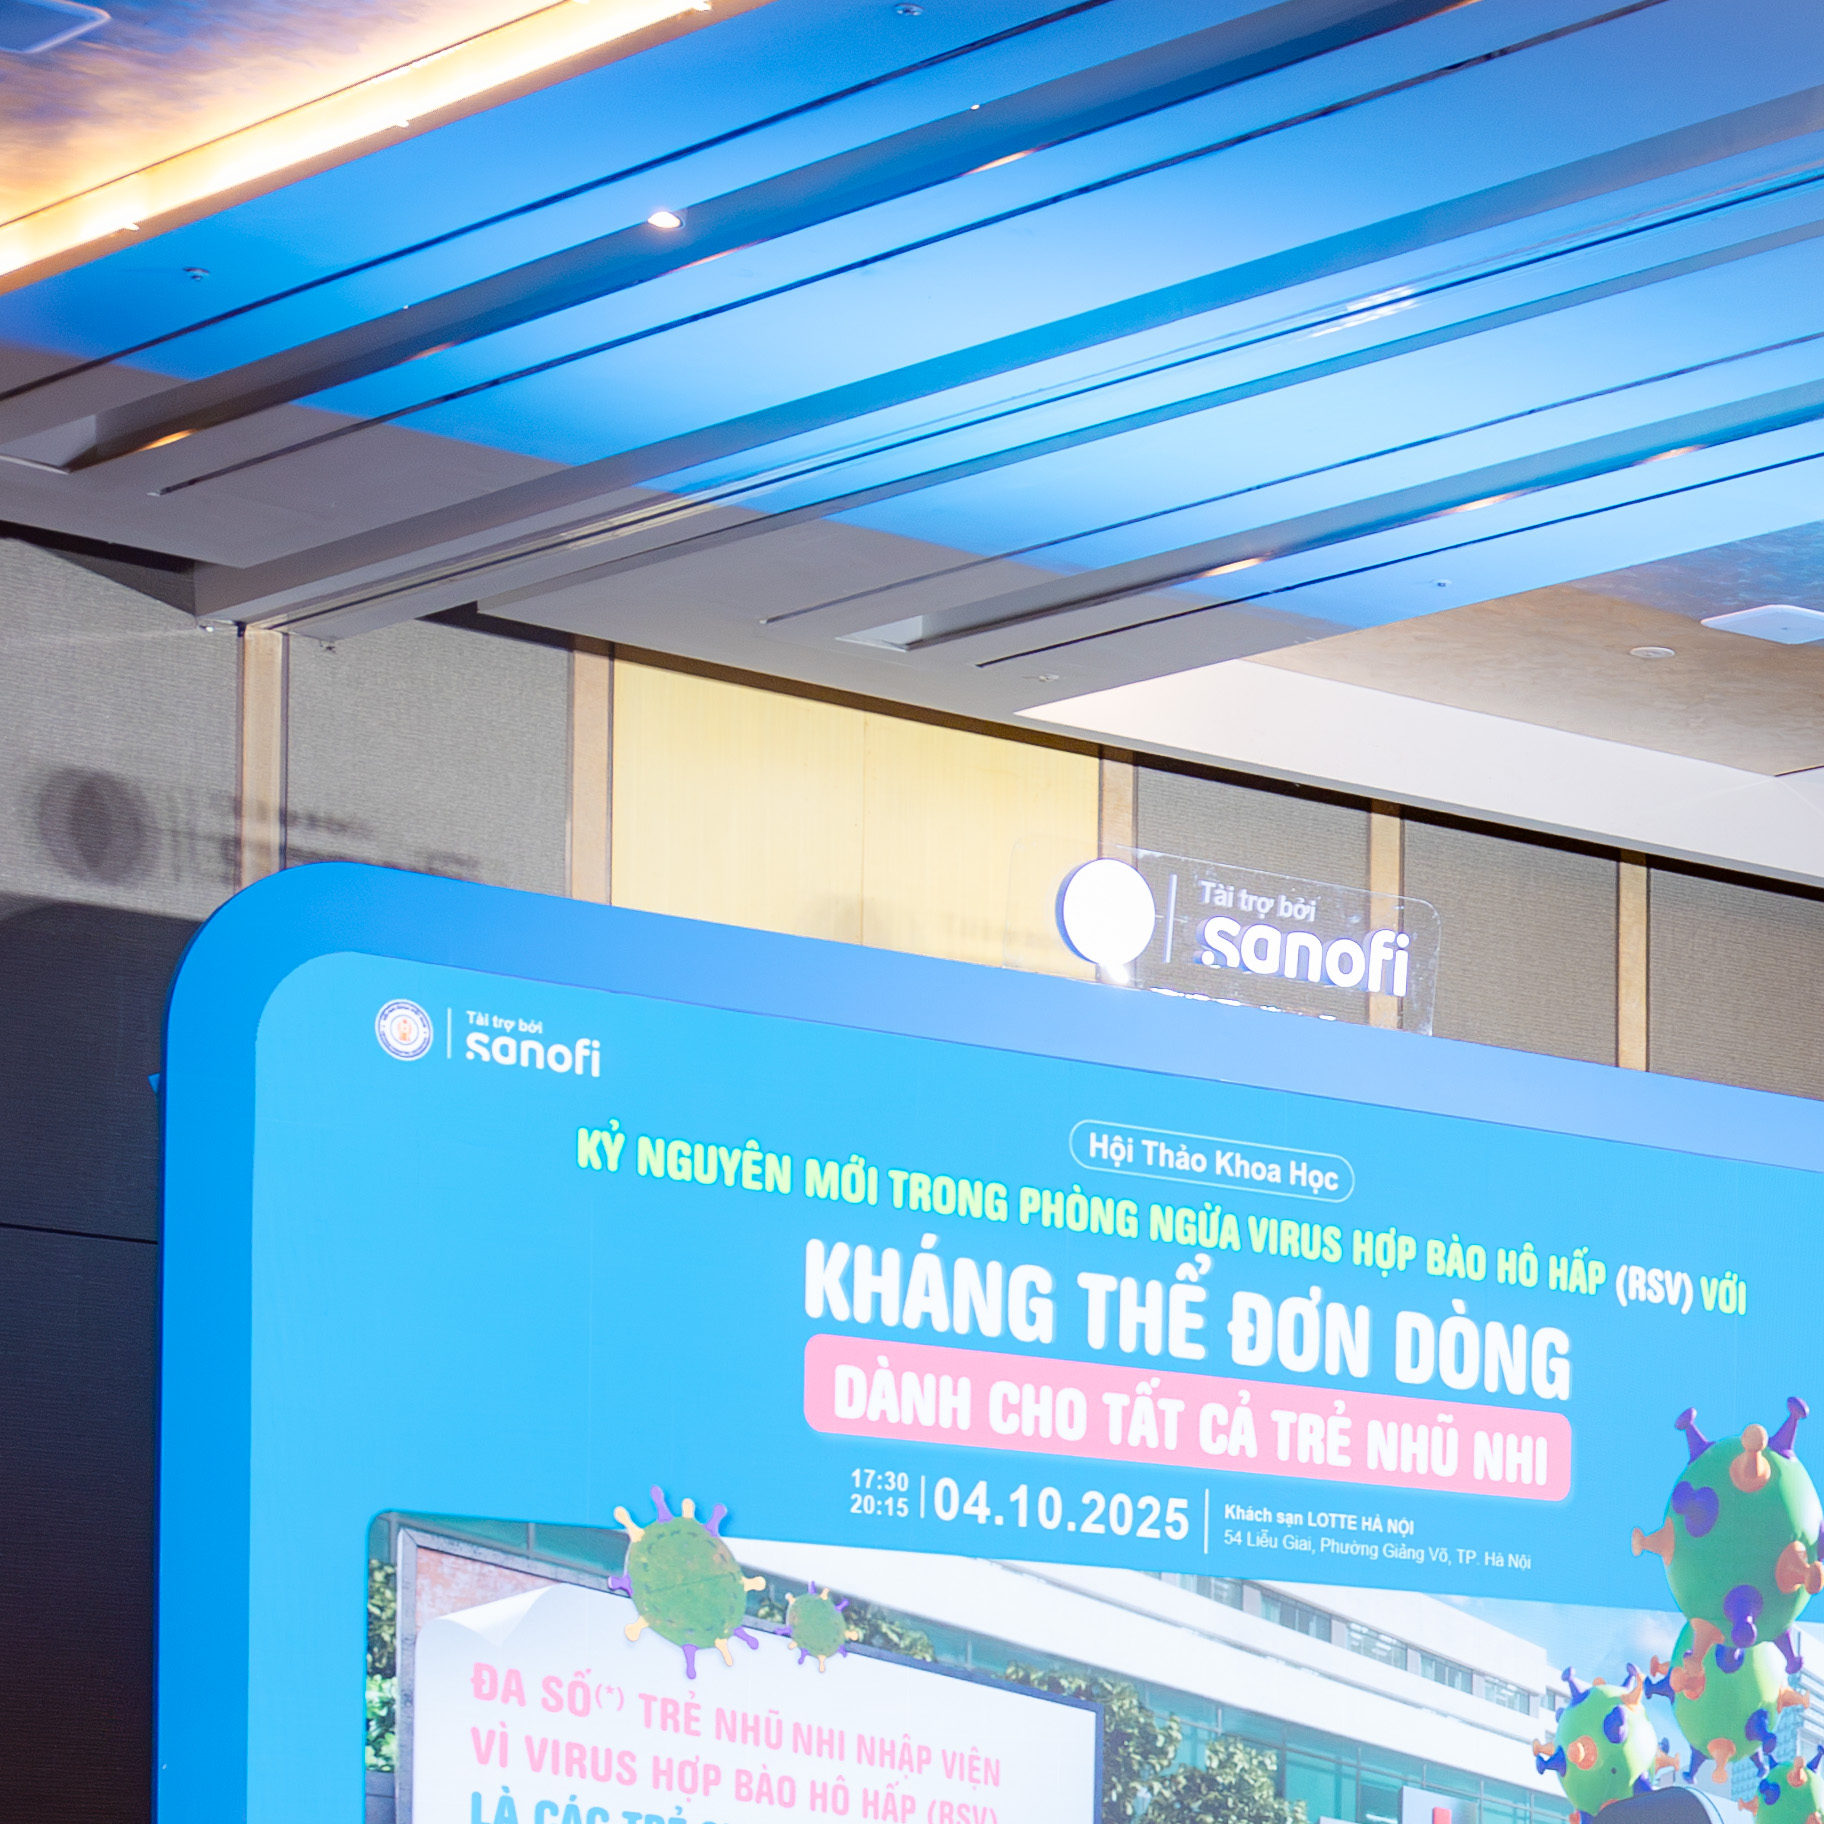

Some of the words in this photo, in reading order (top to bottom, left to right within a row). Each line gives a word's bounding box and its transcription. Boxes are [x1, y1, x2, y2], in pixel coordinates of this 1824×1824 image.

[1200, 880, 1236, 906] Tài
[1239, 888, 1275, 919] trợ
[1276, 895, 1317, 922] bởi
[1198, 915, 1410, 997] sanofi
[466, 1010, 489, 1027] Tài
[492, 1017, 516, 1032] trợ
[518, 1018, 543, 1034] bởi
[465, 1032, 600, 1077] sanofi
[1089, 1132, 1134, 1167] Hội
[1141, 1139, 1207, 1173] Thảo
[1215, 1150, 1282, 1184] Khoa
[1289, 1160, 1339, 1195] Học
[577, 1118, 625, 1172] KỶ
[636, 1137, 792, 1195] NGUYÊN
[804, 1154, 879, 1206] MỚI
[888, 1168, 1008, 1222] TRONG
[1018, 1183, 1139, 1240] PHÒNG
[1150, 1202, 1241, 1252] NGỪA
[1247, 1214, 1343, 1263] VIRUS
[1352, 1226, 1417, 1278] HỢP
[1426, 1232, 1487, 1281] BÀO
[1497, 1241, 1538, 1288] HÔ
[1548, 1246, 1606, 1296] HẤP
[1615, 1264, 1694, 1315] (RSV)
[1699, 1271, 1747, 1316] VỚI
[804, 1233, 1055, 1346] KHÁNG
[1077, 1253, 1214, 1361] THỂ
[1227, 1284, 1371, 1379] ĐƠN
[1395, 1298, 1572, 1401] DÒNG
[833, 1356, 973, 1431] DÀNH
[988, 1379, 1088, 1444] CHO
[1101, 1376, 1188, 1451] TẤT
[1199, 1389, 1258, 1459] CẢ
[1270, 1400, 1352, 1468] TRẺ
[1366, 1413, 1460, 1480] NHŨ
[1473, 1429, 1548, 1487] NHI
[850, 1467, 909, 1494] 17:30
[850, 1493, 909, 1518] 20:15
[933, 1477, 1189, 1541] 04.10.2025
[1223, 1530, 1244, 1547] 54
[1247, 1527, 1278, 1551] Liễu
[1282, 1533, 1316, 1555] Giai,
[1320, 1536, 1379, 1563] Phường
[1382, 1538, 1425, 1565] Giảng
[1457, 1549, 1480, 1567] TP.
[1484, 1549, 1503, 1569] Hà
[1506, 1551, 1531, 1571] Nội
[1224, 1503, 1272, 1526] Khách
[1275, 1511, 1303, 1529] sạn
[1307, 1510, 1357, 1532] LOTTE
[1386, 1514, 1414, 1537] NỘI
[471, 1662, 526, 1708] ĐA
[638, 1690, 702, 1738] TRẺ
[715, 1706, 783, 1750] NHŨ
[793, 1722, 845, 1762] NHI
[856, 1734, 932, 1777] NHẬP
[941, 1746, 1001, 1792] VIỆN
[471, 1721, 509, 1769] VÌ
[524, 1734, 638, 1786] VIRUS
[651, 1755, 722, 1803] HỢP
[734, 1761, 797, 1809] BÀO
[809, 1772, 851, 1817] HÔ
[862, 1778, 917, 1824] HẤP
